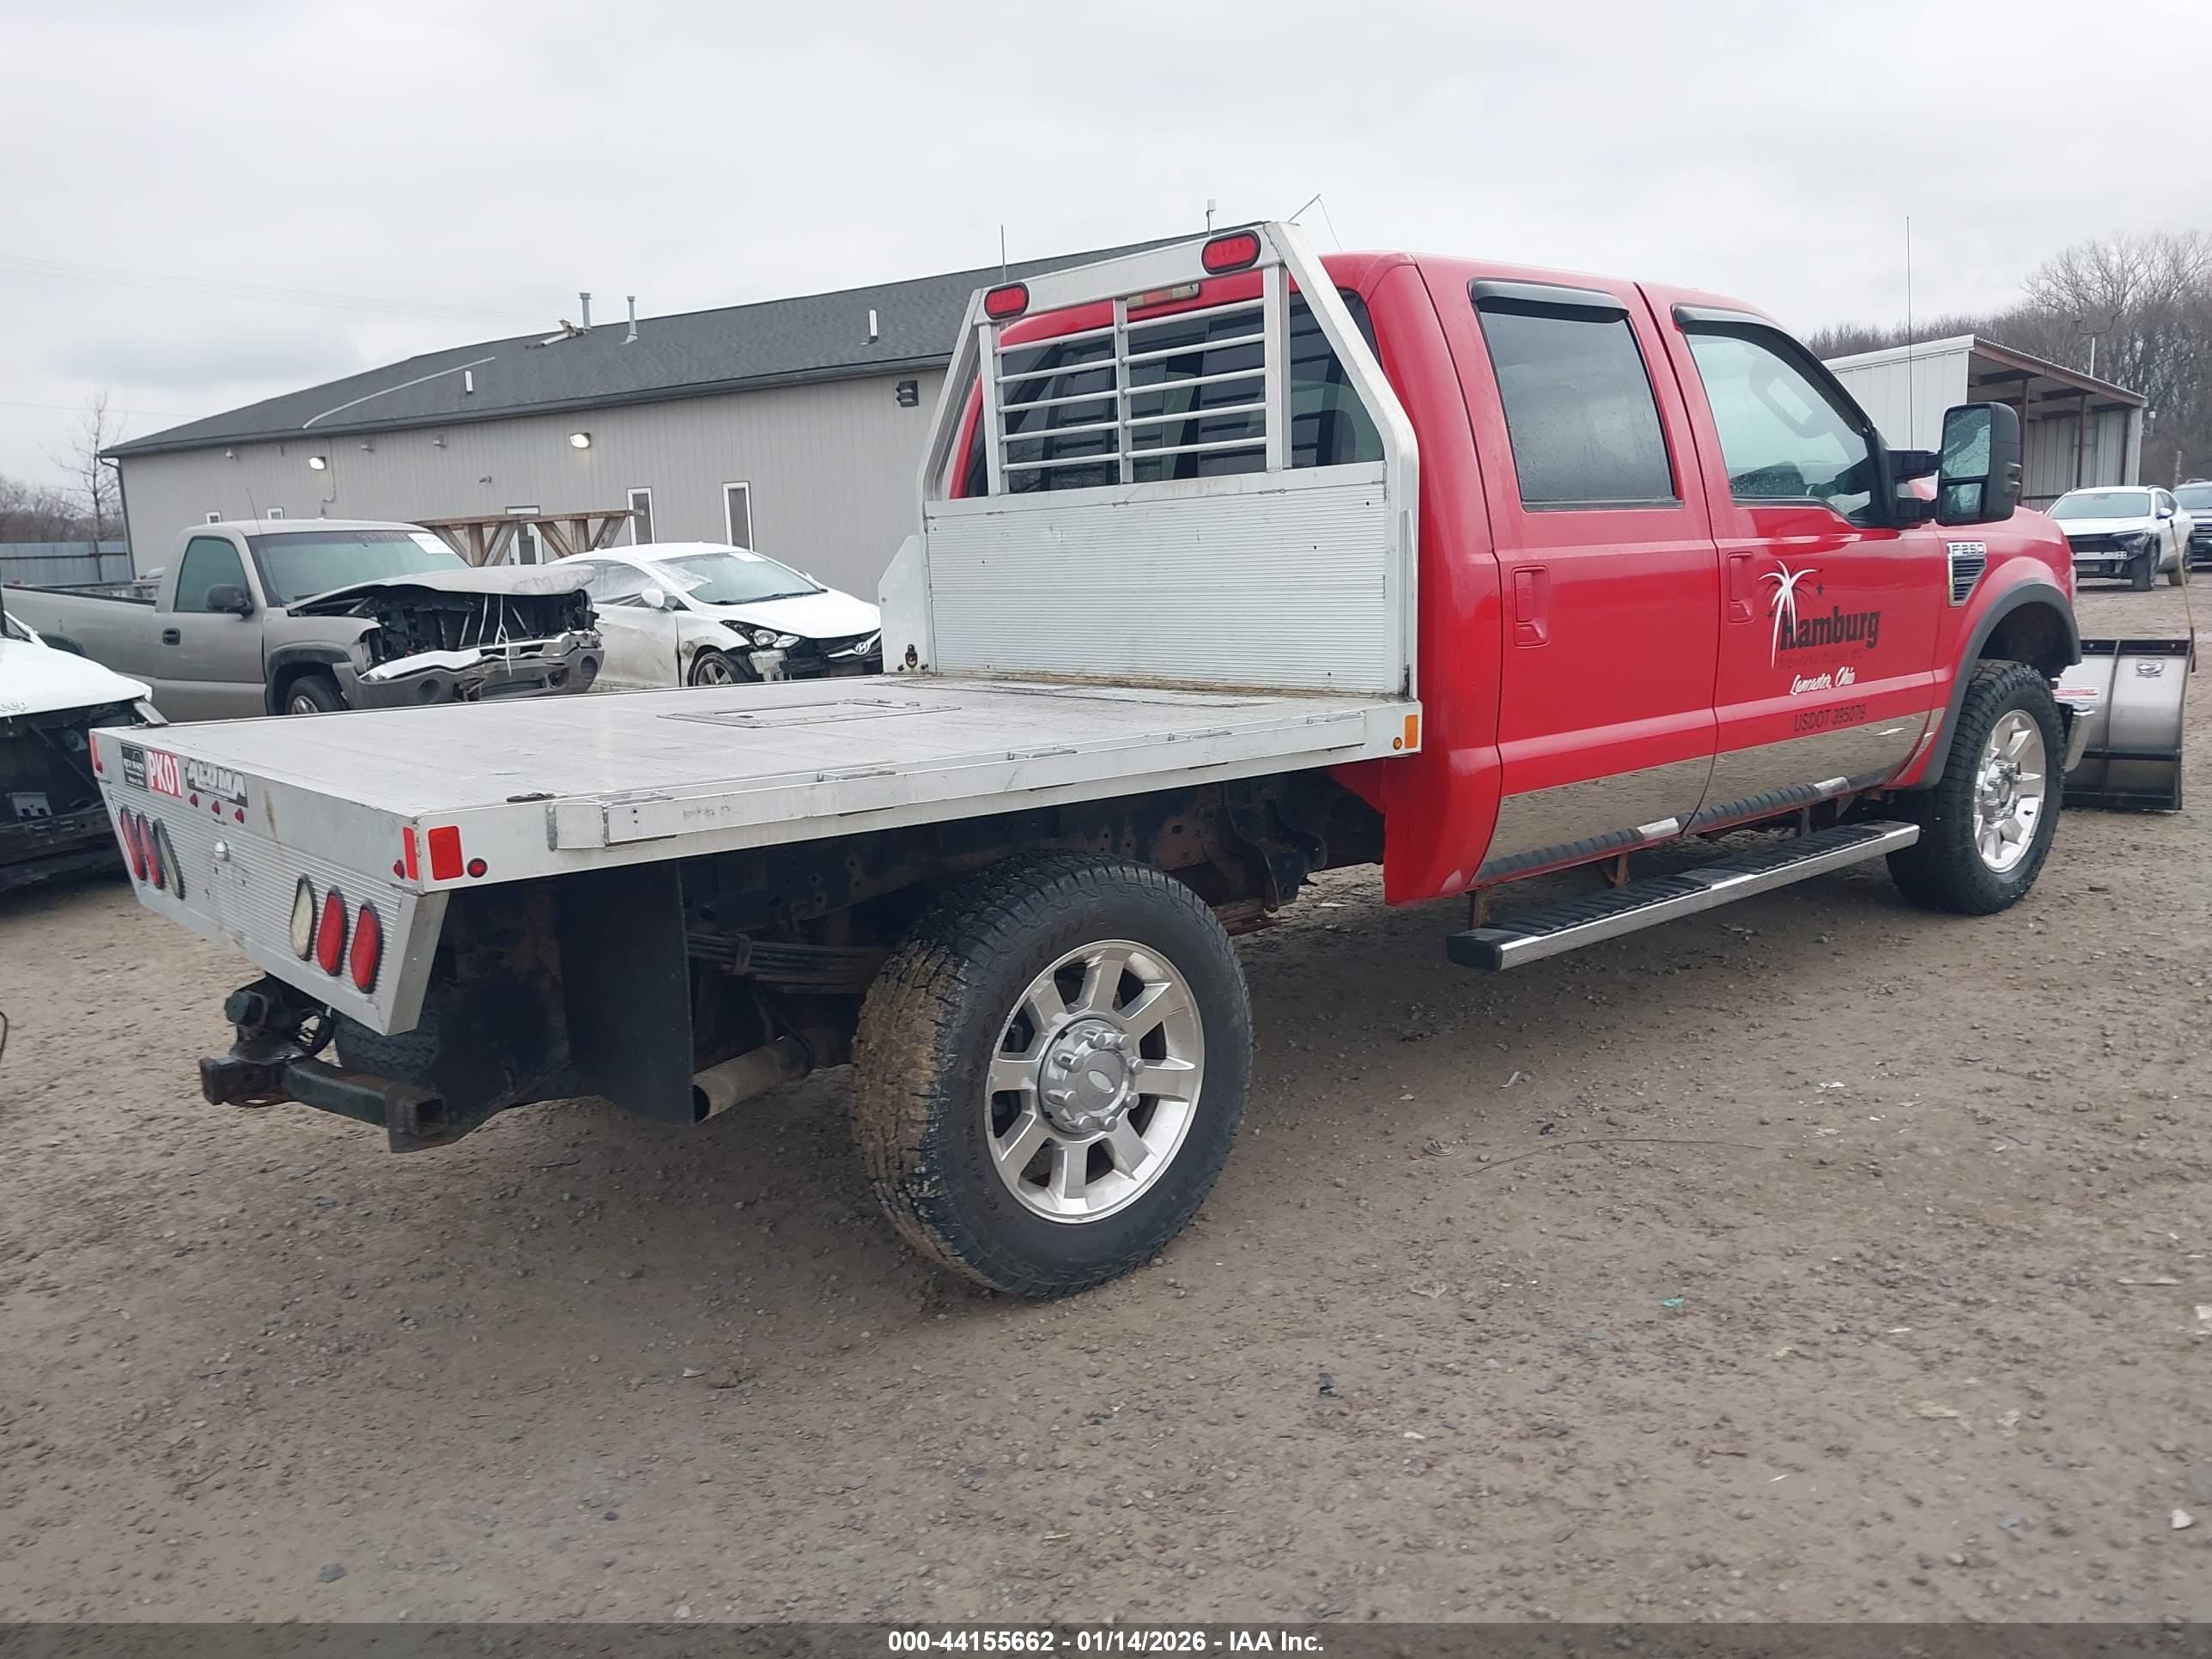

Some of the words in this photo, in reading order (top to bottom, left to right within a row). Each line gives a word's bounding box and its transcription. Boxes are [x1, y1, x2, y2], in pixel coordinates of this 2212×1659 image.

[1779, 605, 1881, 650] Hamburg
[0, 700, 27, 713] eep
[1794, 708, 1832, 732] USDOT
